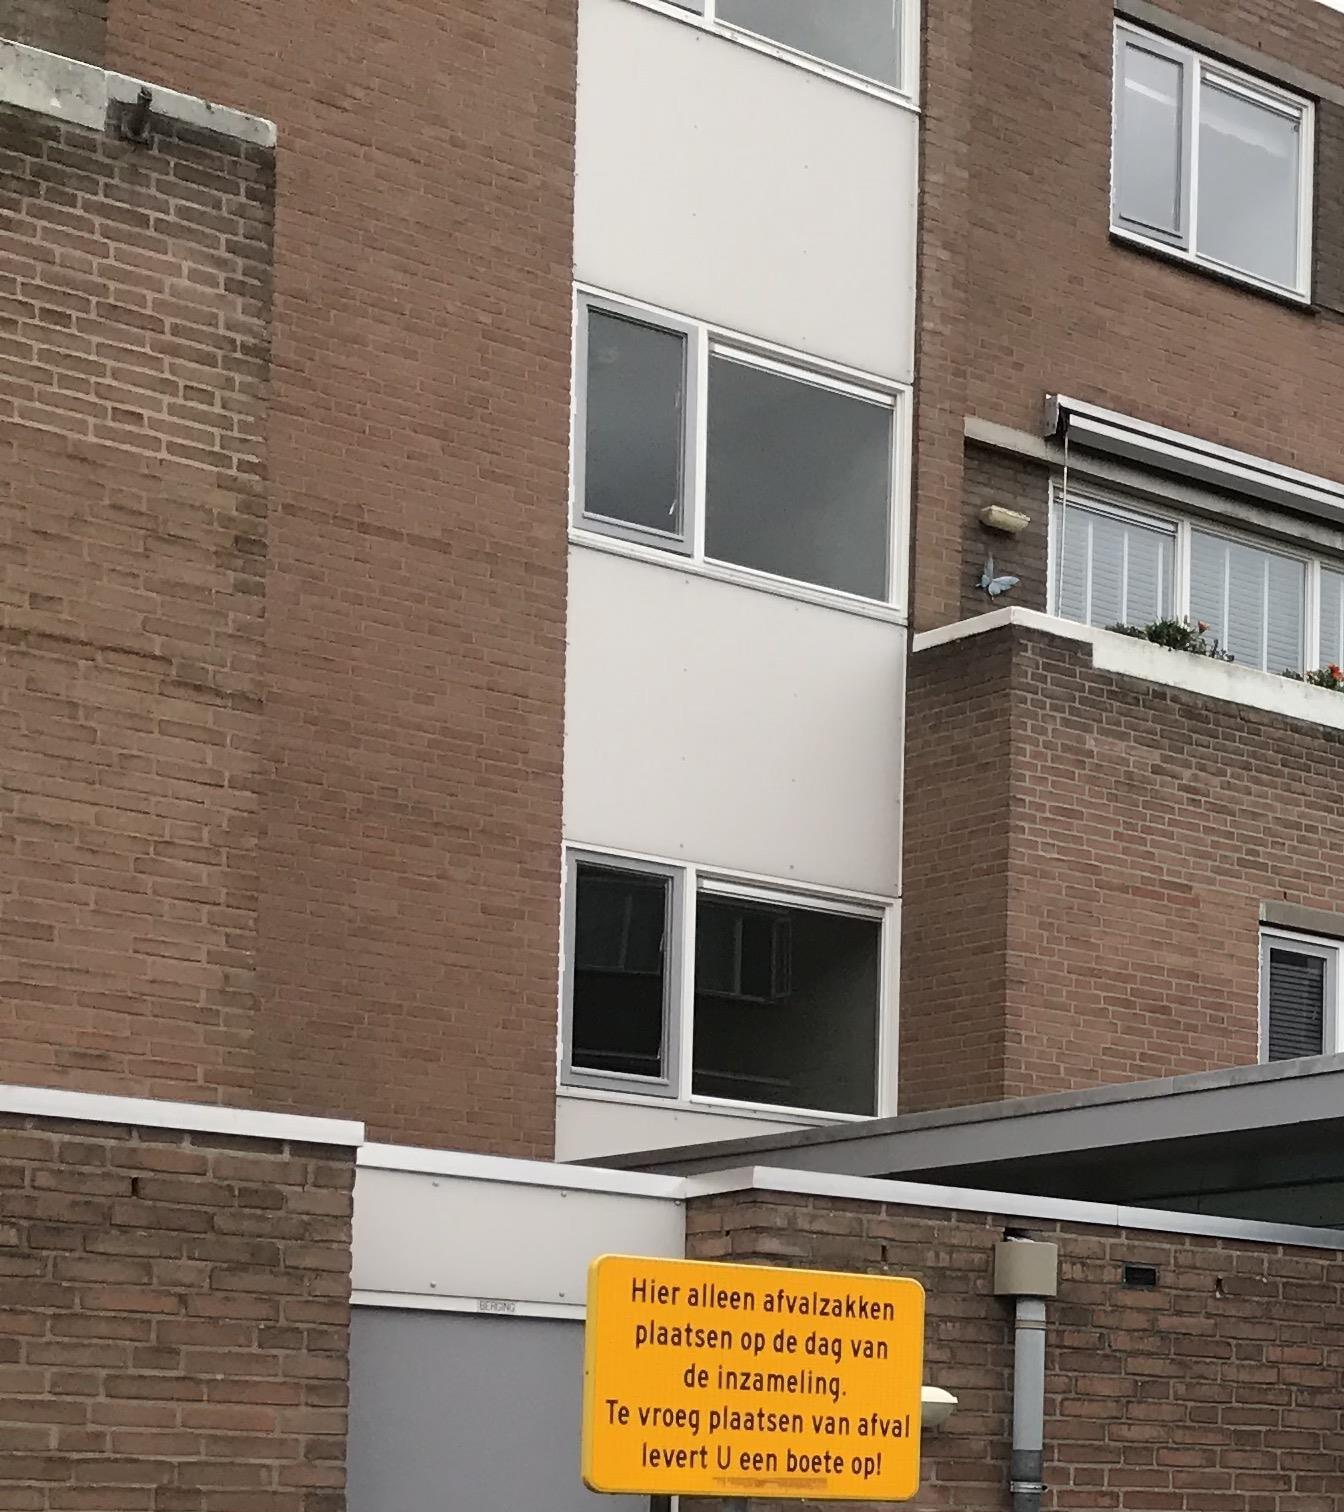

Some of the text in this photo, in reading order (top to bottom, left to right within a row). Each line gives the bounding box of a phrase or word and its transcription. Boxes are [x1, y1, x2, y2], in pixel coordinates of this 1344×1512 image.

[631, 1277, 895, 1321] Hier alleen afvalzakken
[635, 1320, 889, 1364] plaatsen op de dag van
[683, 1364, 847, 1403] de inzameling.
[606, 1399, 910, 1438] Te vroeg plaatsen van afval
[642, 1443, 882, 1480] levert U een boete op!
